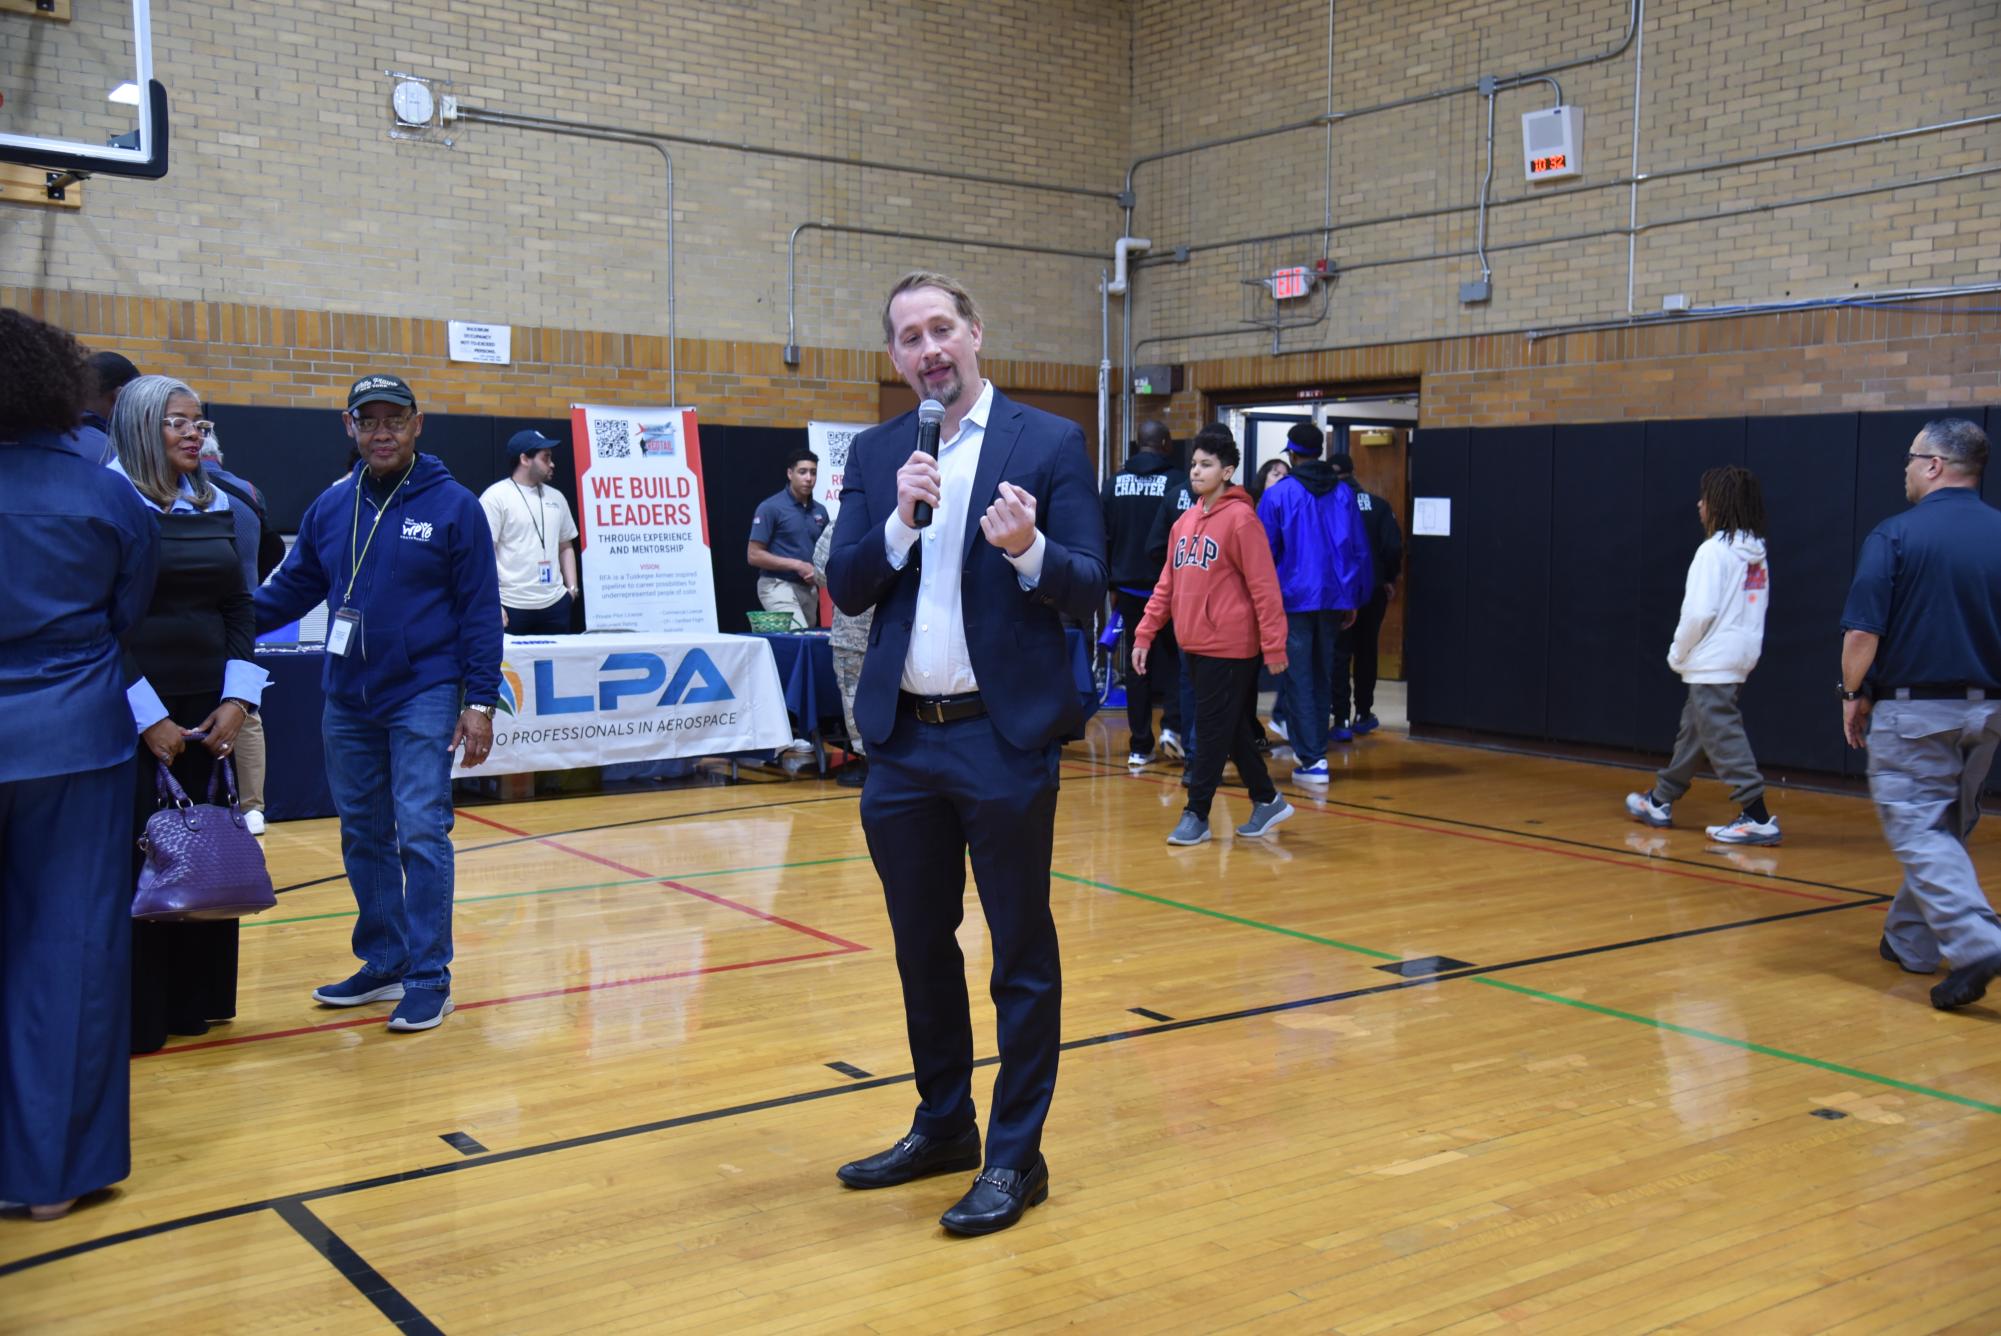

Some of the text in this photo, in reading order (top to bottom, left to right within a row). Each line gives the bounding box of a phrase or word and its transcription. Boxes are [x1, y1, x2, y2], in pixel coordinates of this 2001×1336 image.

[1277, 267, 1302, 297] EXIT
[591, 476, 690, 499] WE BUILD
[1114, 483, 1166, 497] CHAPTER
[596, 503, 691, 527] LEADERS
[598, 532, 693, 543] THROUGH EXPERIENCE
[610, 544, 684, 555] AND MENTORSHIP
[1173, 534, 1219, 571] GAP
[640, 563, 660, 571] VISION
[533, 647, 736, 716] LPA
[512, 722, 634, 744] PROFESSIONALS
[638, 720, 653, 734] IN
[657, 712, 737, 733] AEROSPACE
